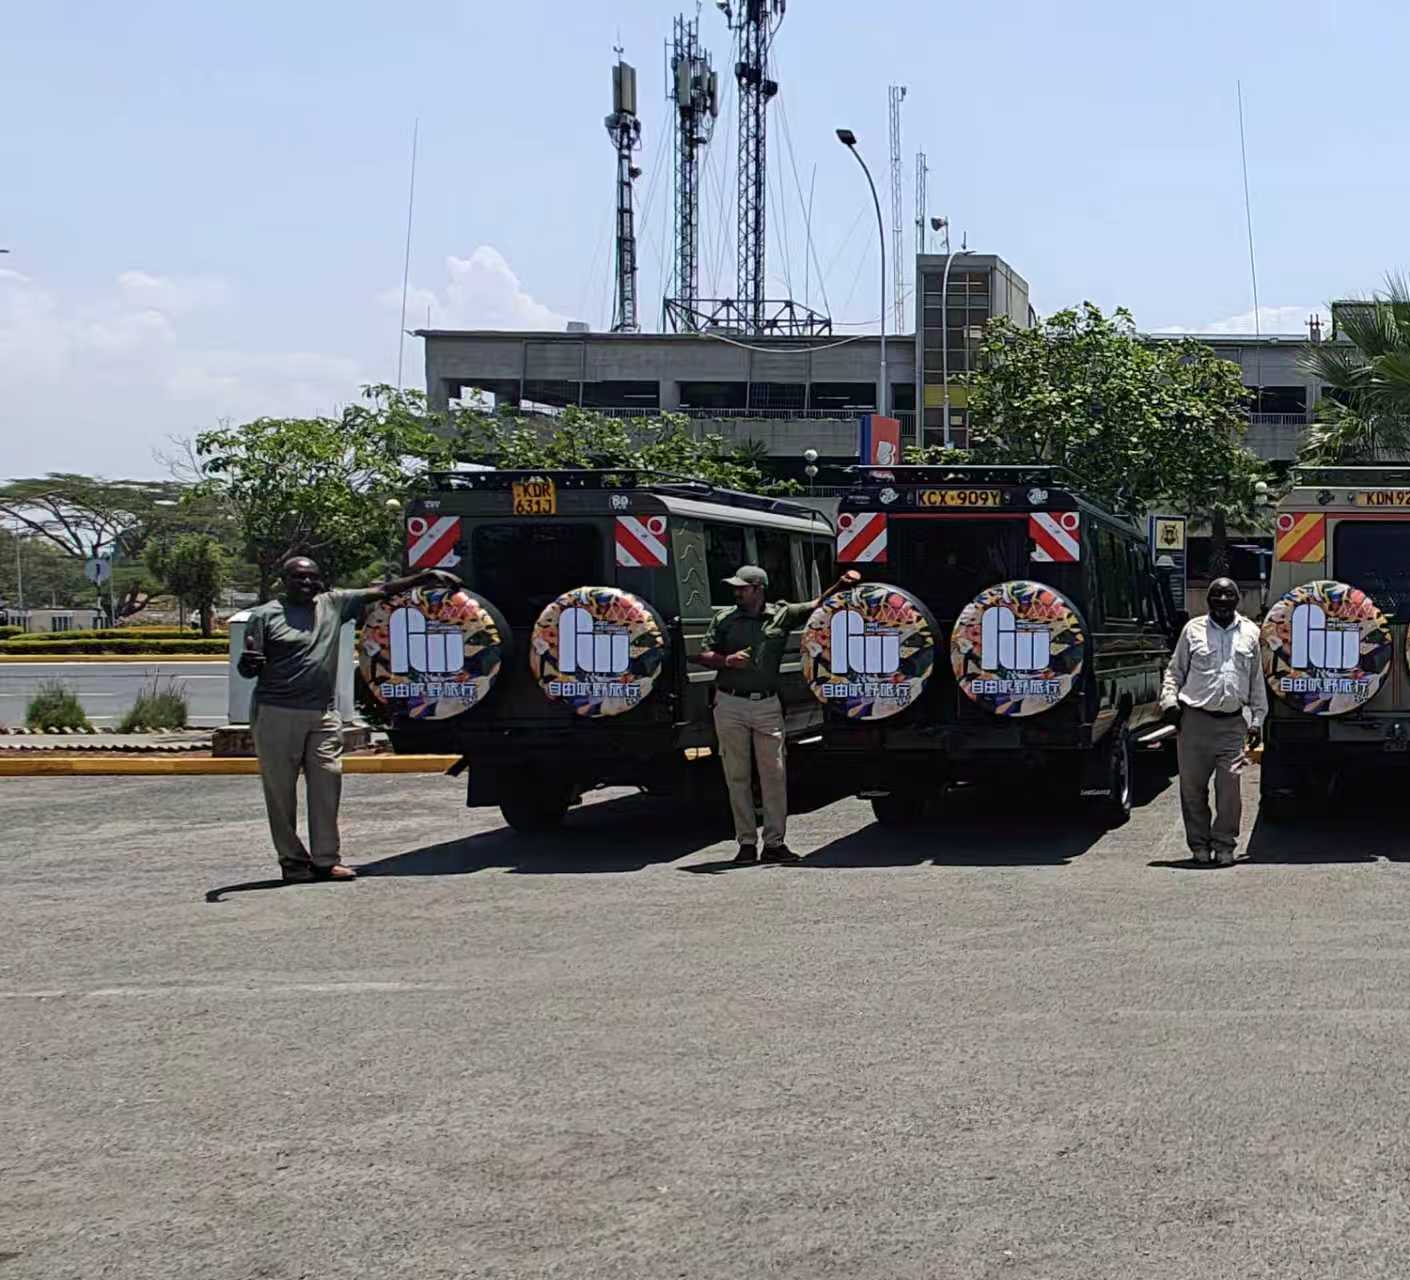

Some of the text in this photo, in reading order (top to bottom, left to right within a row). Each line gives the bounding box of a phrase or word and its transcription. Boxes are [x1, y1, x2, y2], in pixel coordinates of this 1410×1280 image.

[522, 483, 551, 497] KDR
[1367, 491, 1394, 505] KDN
[516, 499, 551, 514] 631J
